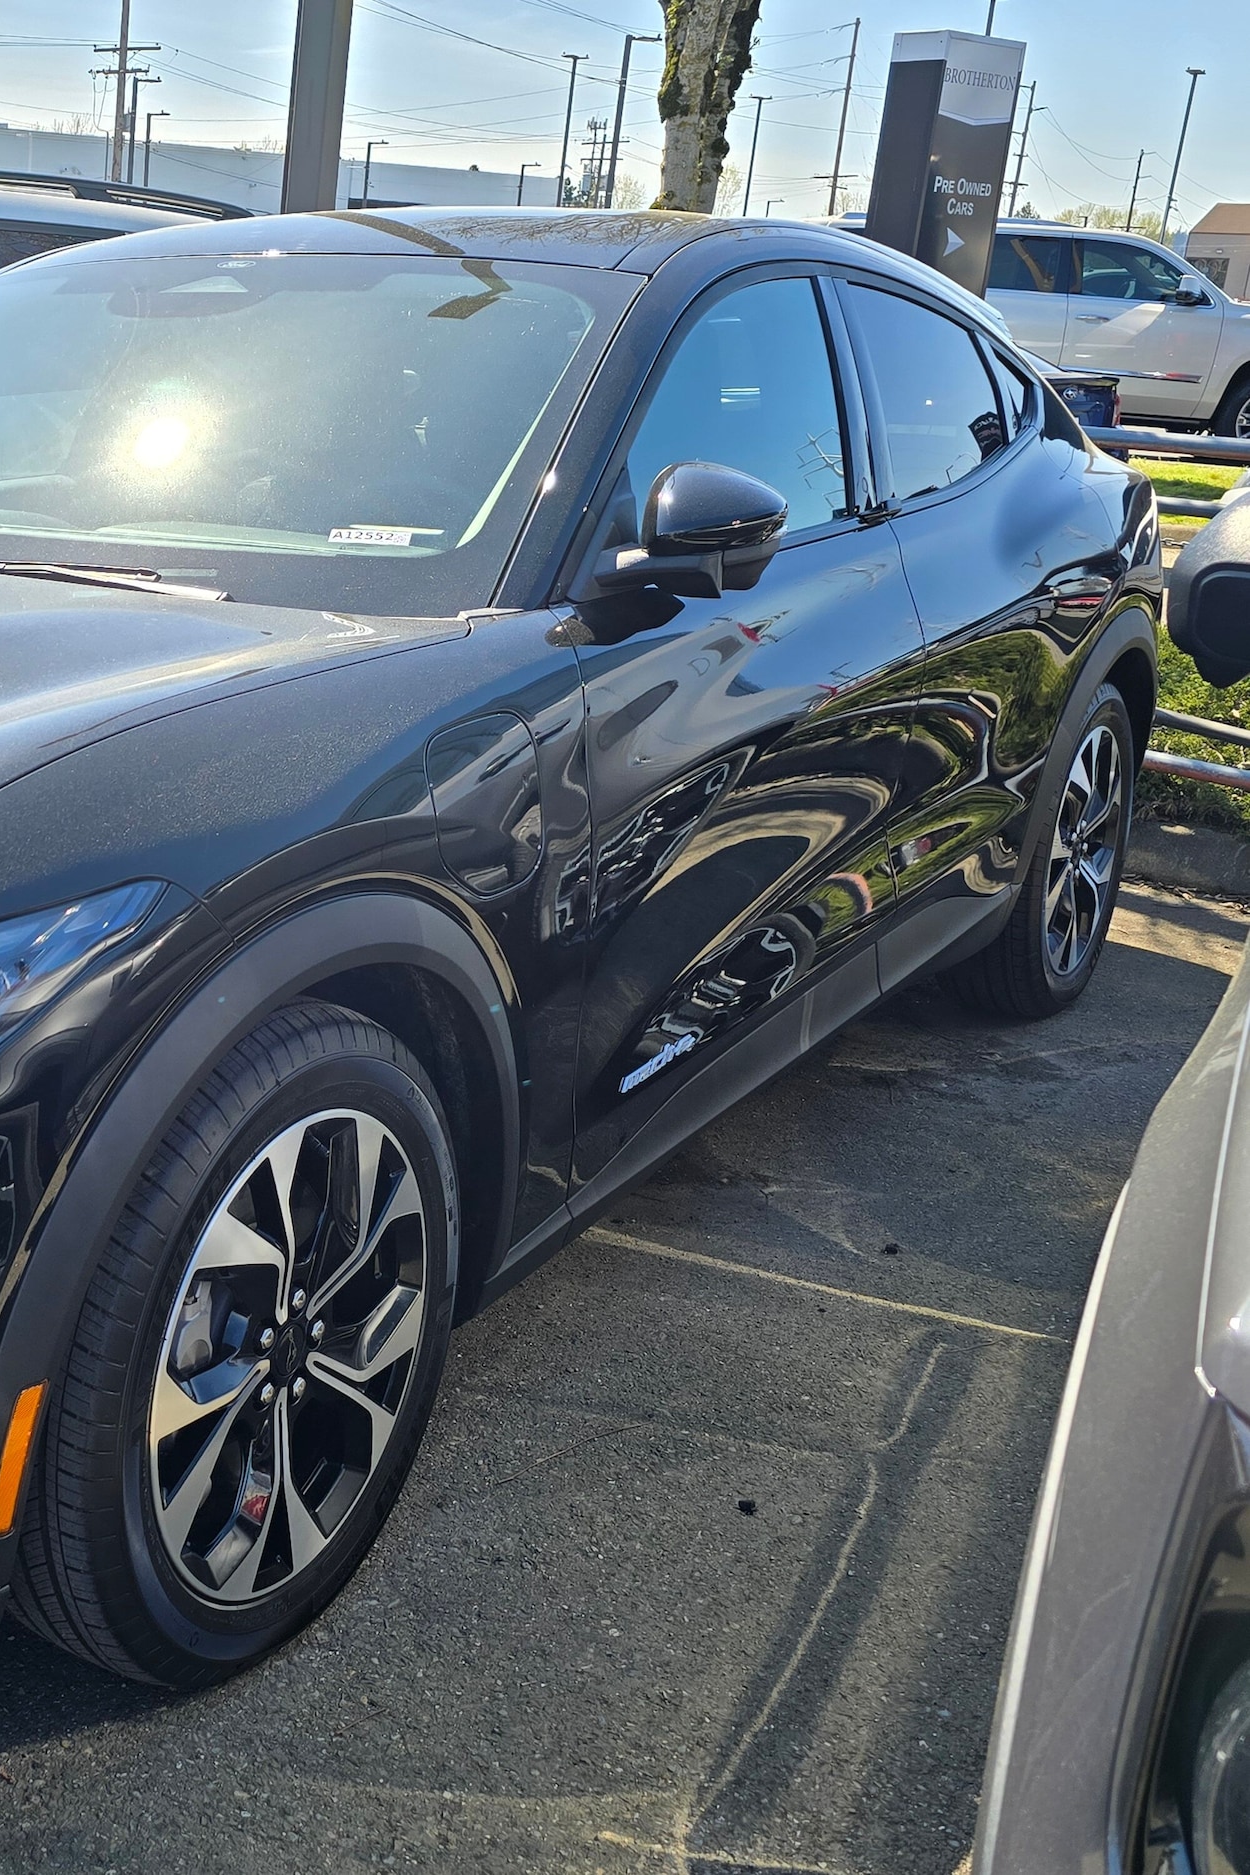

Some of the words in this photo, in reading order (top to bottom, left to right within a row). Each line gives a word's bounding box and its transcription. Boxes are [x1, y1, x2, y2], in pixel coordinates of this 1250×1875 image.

[944, 67, 1016, 91] BROTHERTON
[933, 175, 955, 194] PRE
[957, 178, 992, 197] OWNED
[947, 197, 974, 216] CARS
[332, 531, 394, 541] A12552
